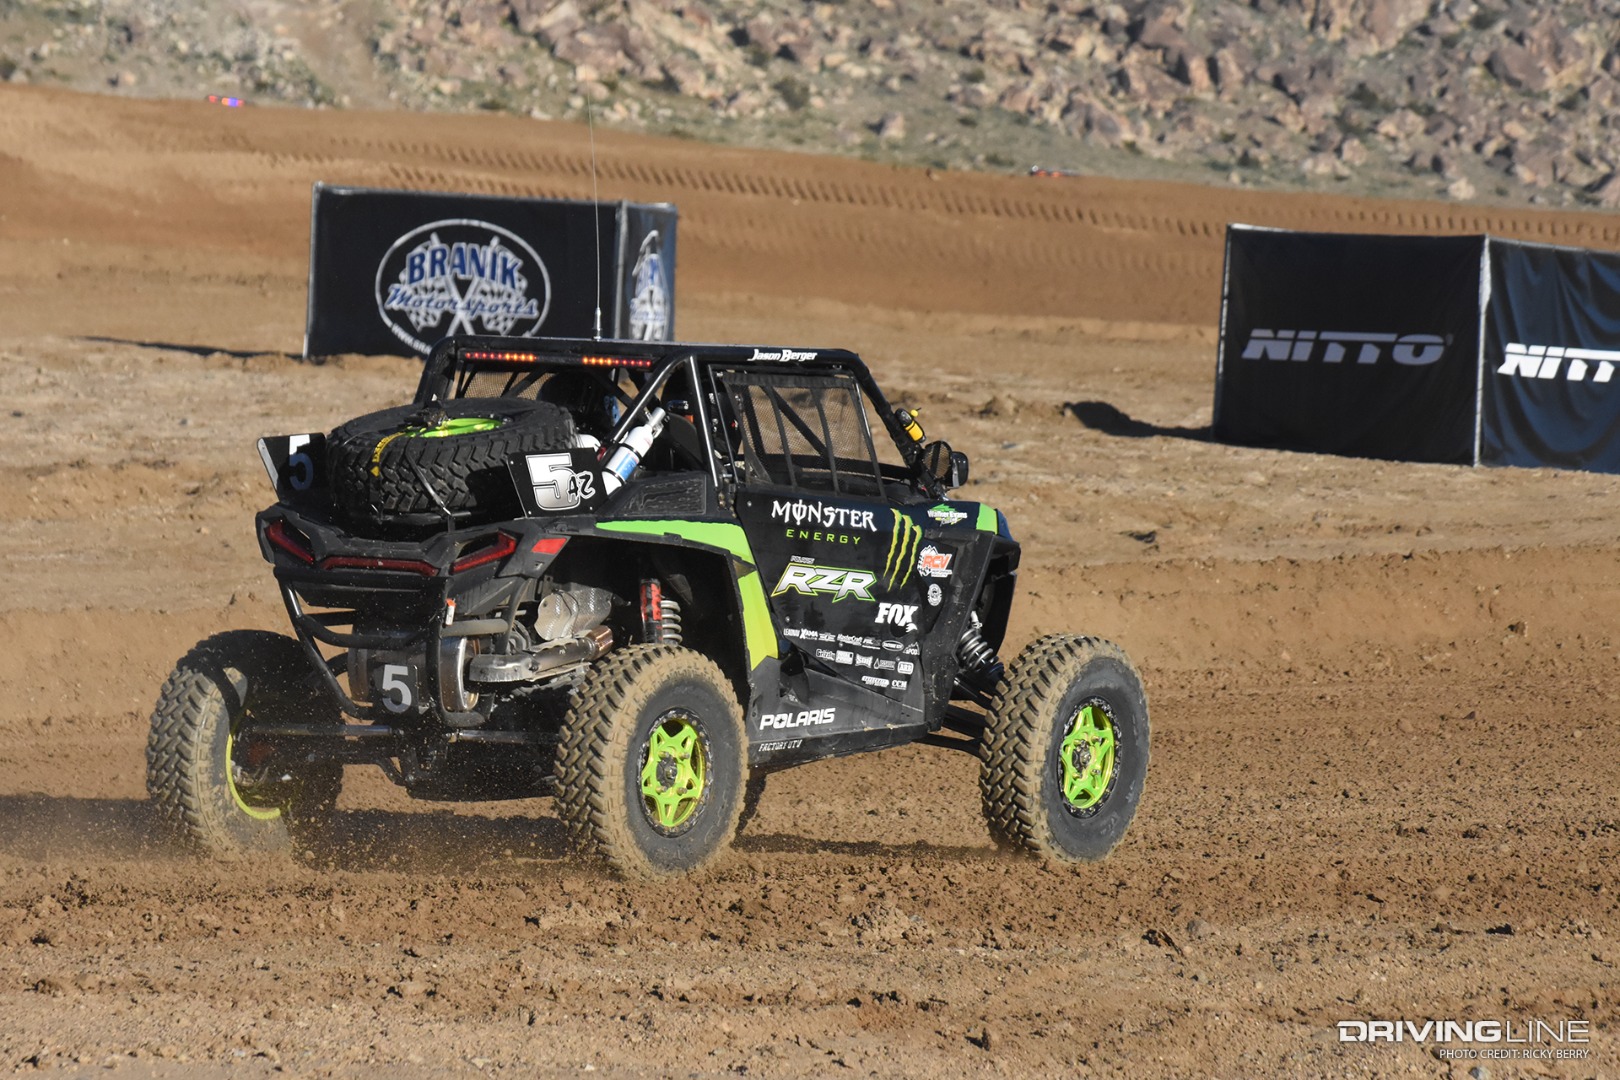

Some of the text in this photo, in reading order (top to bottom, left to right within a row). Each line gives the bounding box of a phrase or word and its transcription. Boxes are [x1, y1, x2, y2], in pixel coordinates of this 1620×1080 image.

[405, 243, 521, 291] BRANIK
[385, 284, 539, 319] Motorsports
[747, 348, 818, 362] Jason Berger
[1241, 329, 1445, 365] NITTO
[289, 434, 314, 490] 5
[525, 452, 581, 511] 5
[771, 499, 877, 532] MONSTER
[786, 529, 862, 545] ENERGY
[921, 554, 952, 570] RCV
[771, 562, 877, 603] RZR
[875, 602, 918, 627] FOX
[382, 664, 412, 714] 5
[759, 707, 836, 731] POLARIS
[758, 739, 803, 752] FACTORY UTV
